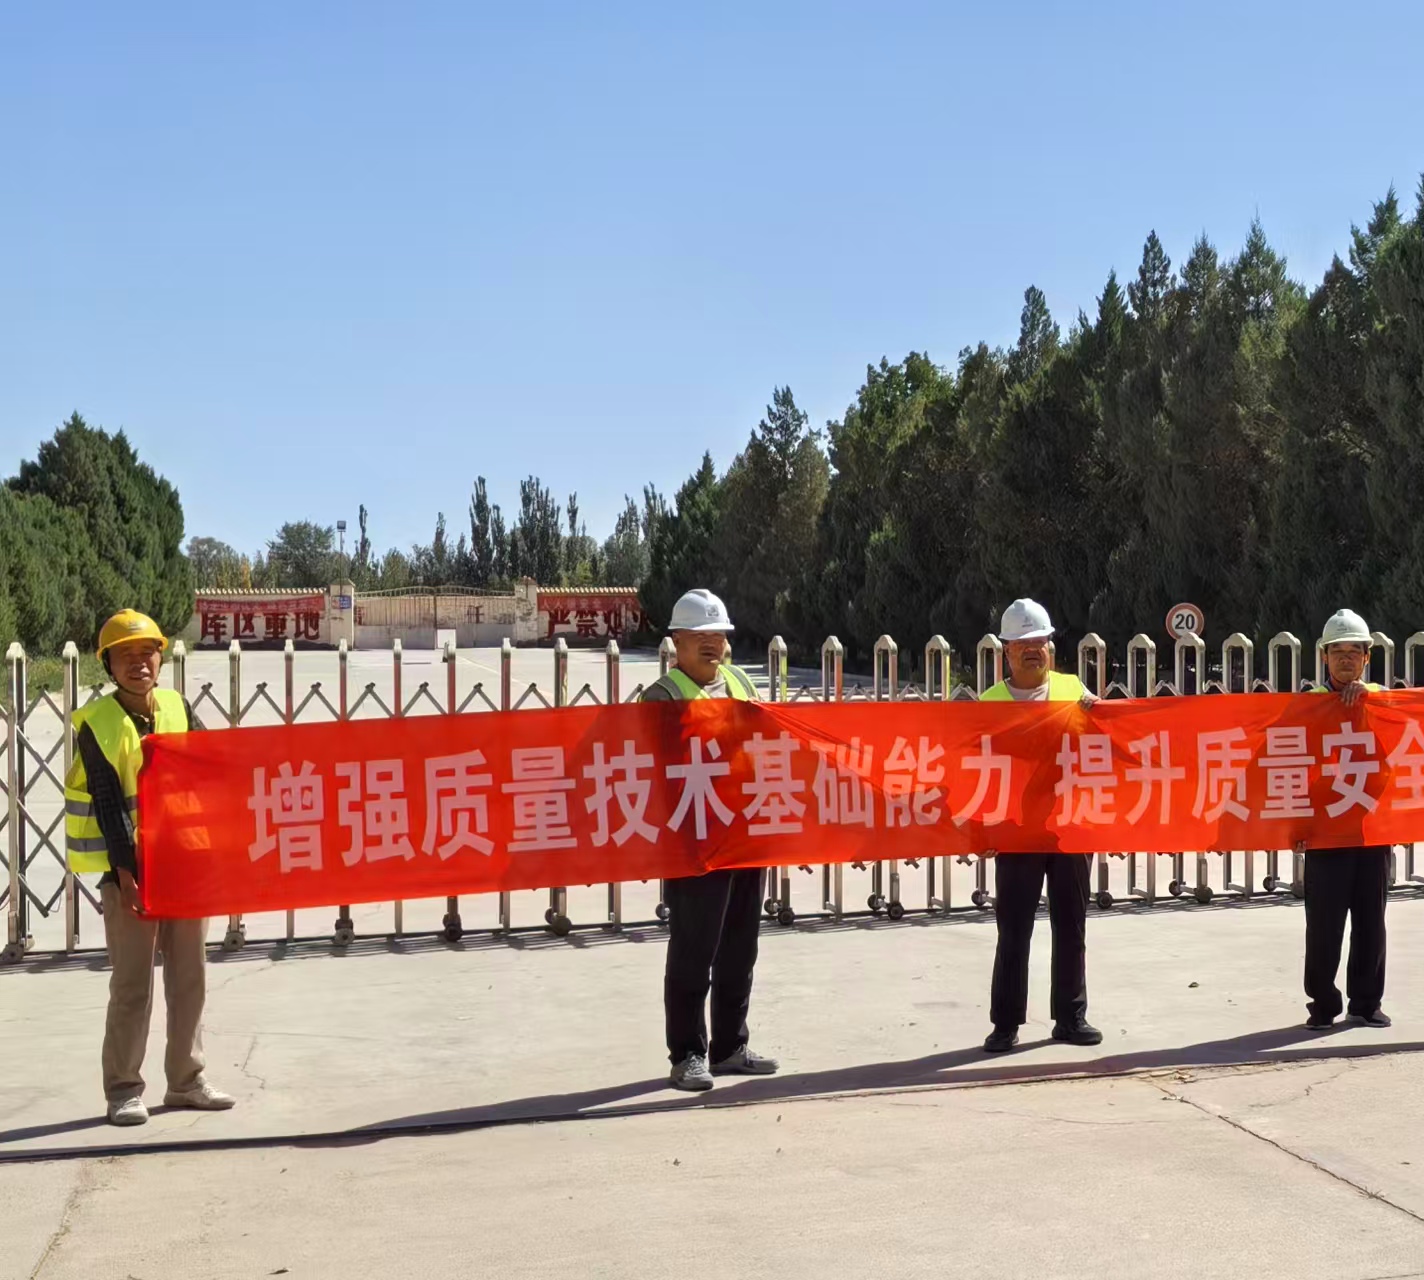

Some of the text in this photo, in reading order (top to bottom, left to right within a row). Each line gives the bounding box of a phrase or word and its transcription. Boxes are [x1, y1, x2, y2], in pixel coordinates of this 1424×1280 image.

[200, 608, 321, 642] 库区重地
[1174, 613, 1195, 630] 20
[248, 733, 1012, 872] 增强质量技术基础能力
